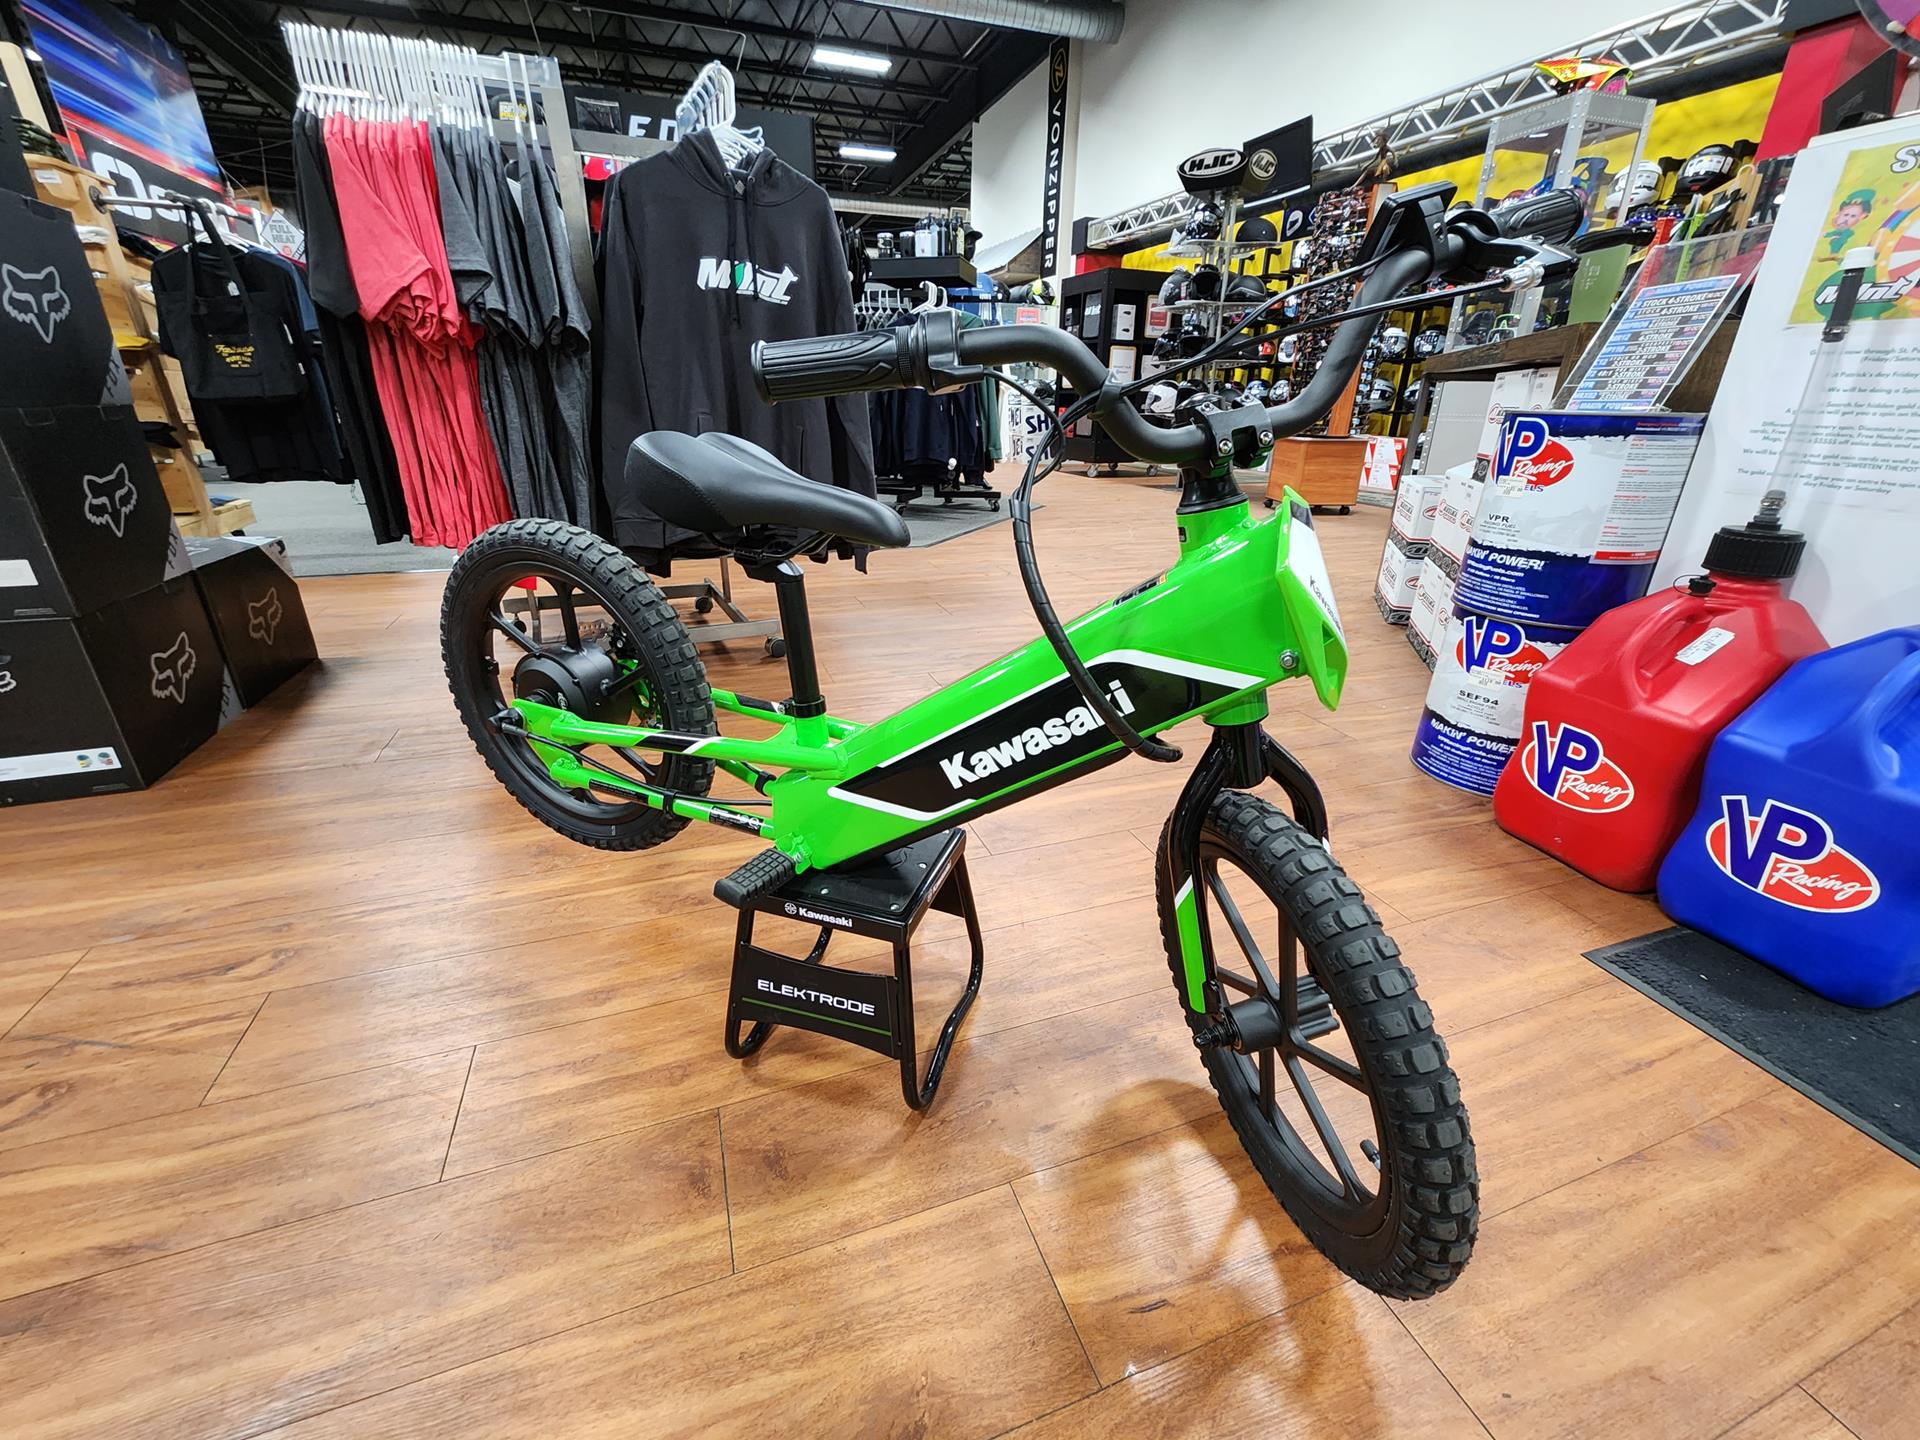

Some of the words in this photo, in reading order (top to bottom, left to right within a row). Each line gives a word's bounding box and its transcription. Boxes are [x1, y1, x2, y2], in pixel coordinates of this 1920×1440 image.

[1188, 153, 1236, 173] HJC
[1253, 155, 1275, 174] HJC
[1043, 99, 1062, 269] VONZIPPER
[1641, 299, 1667, 308] STOCK
[1668, 293, 1706, 304] 4-STROKE
[1815, 276, 1912, 305] Mnt
[1661, 305, 1700, 315] 4-STROKE
[1612, 371, 1646, 379] 2-STROKE
[1605, 383, 1640, 391] 2-STROKE
[1025, 413, 1053, 434] SH
[1858, 424, 1896, 432] Discounts
[1494, 417, 1550, 485] VP
[1513, 458, 1574, 481] Racing
[1884, 464, 1899, 472] THE
[1524, 484, 1544, 492] ELS
[1817, 482, 1843, 490] Friday
[1853, 485, 1892, 496] Saturday
[1488, 513, 1510, 523] VPR
[1488, 552, 1545, 570] POWER!
[1464, 616, 1525, 674] VP
[1489, 658, 1543, 679] Racing
[1458, 689, 1500, 706] SEF94
[1430, 717, 1467, 740] MAKIN'
[1438, 735, 1505, 761] VPRacingFuels.com
[1533, 721, 1604, 801] VP
[1560, 774, 1632, 803] Racing
[1722, 796, 1834, 892] VP
[1768, 862, 1874, 901] Racing
[799, 907, 853, 928] Kawasaki
[757, 979, 875, 1016] ELEKTRODE
